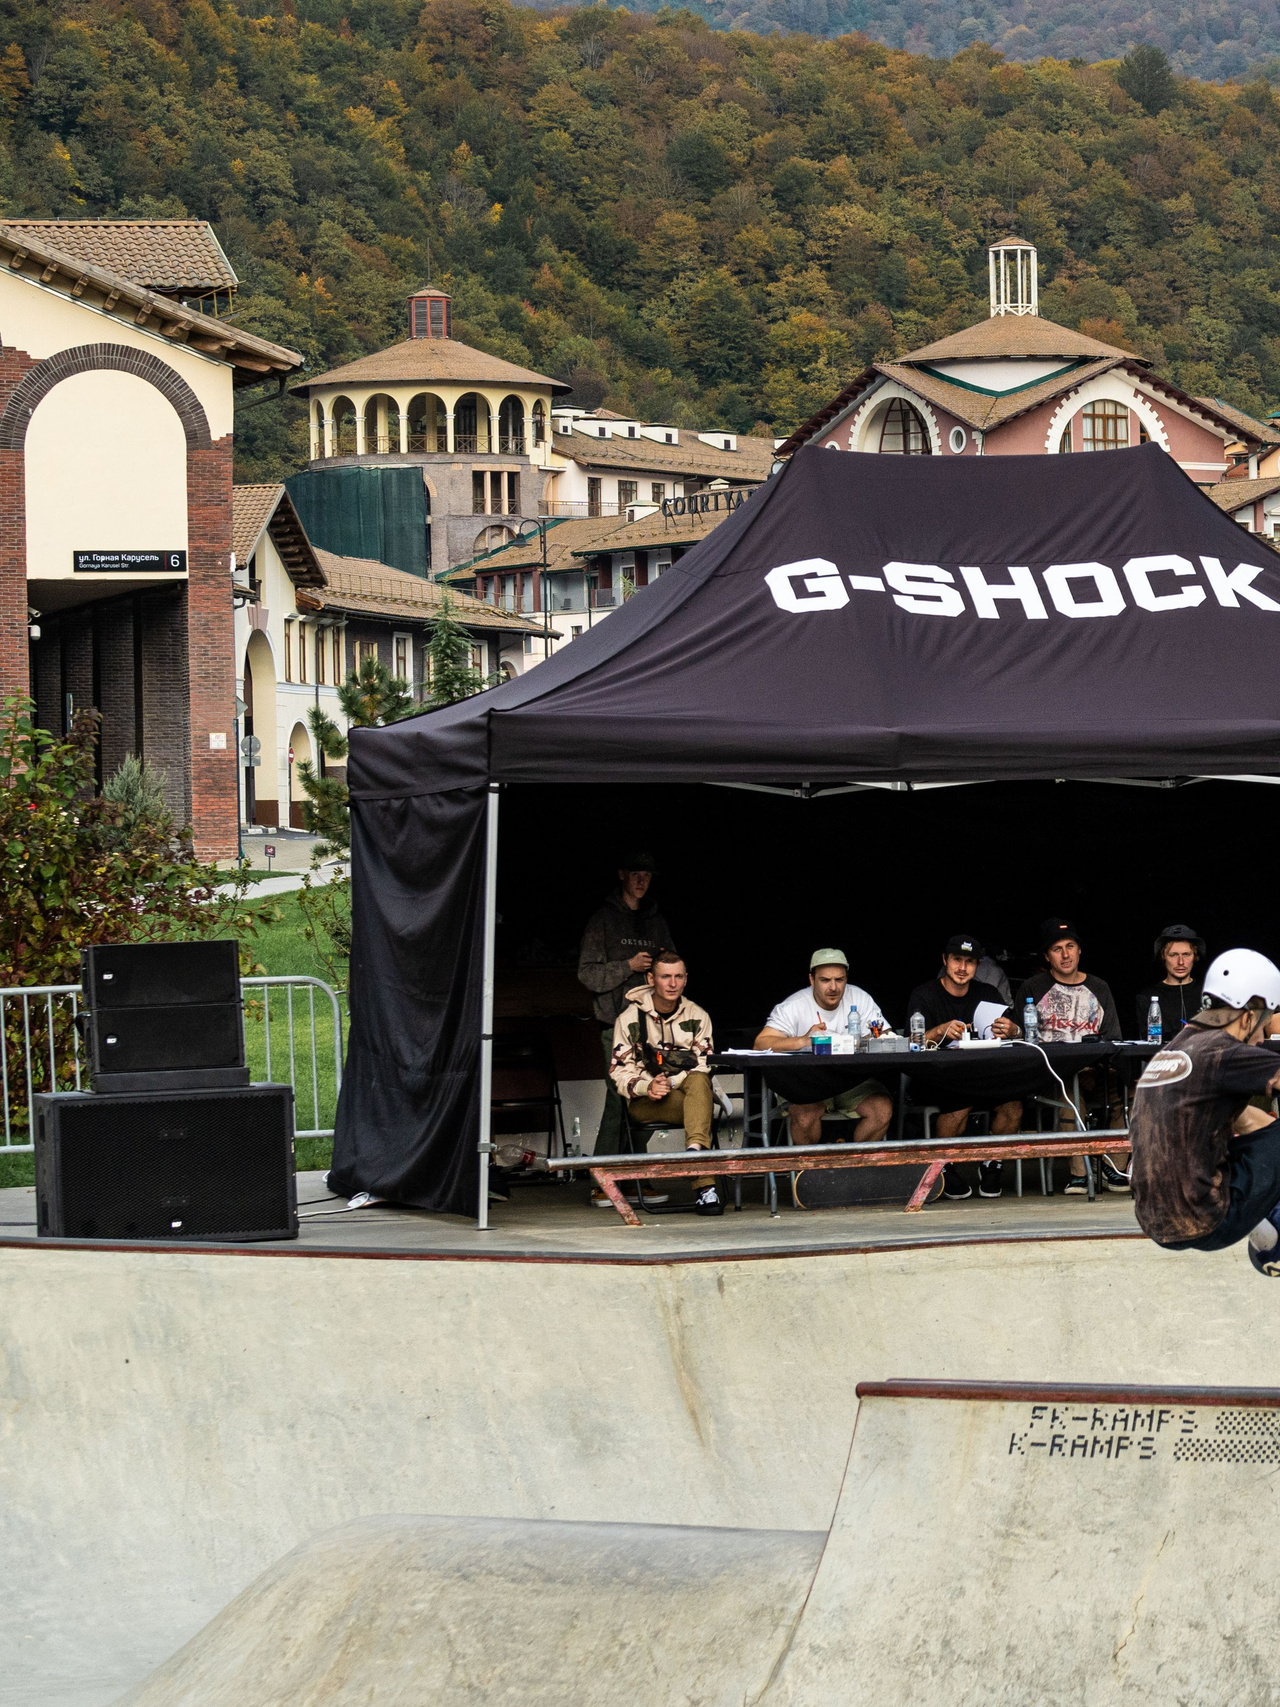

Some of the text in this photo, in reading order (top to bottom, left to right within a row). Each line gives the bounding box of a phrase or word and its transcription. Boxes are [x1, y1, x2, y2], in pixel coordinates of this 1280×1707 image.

[78, 553, 180, 568] ул. Горная Карусель 6
